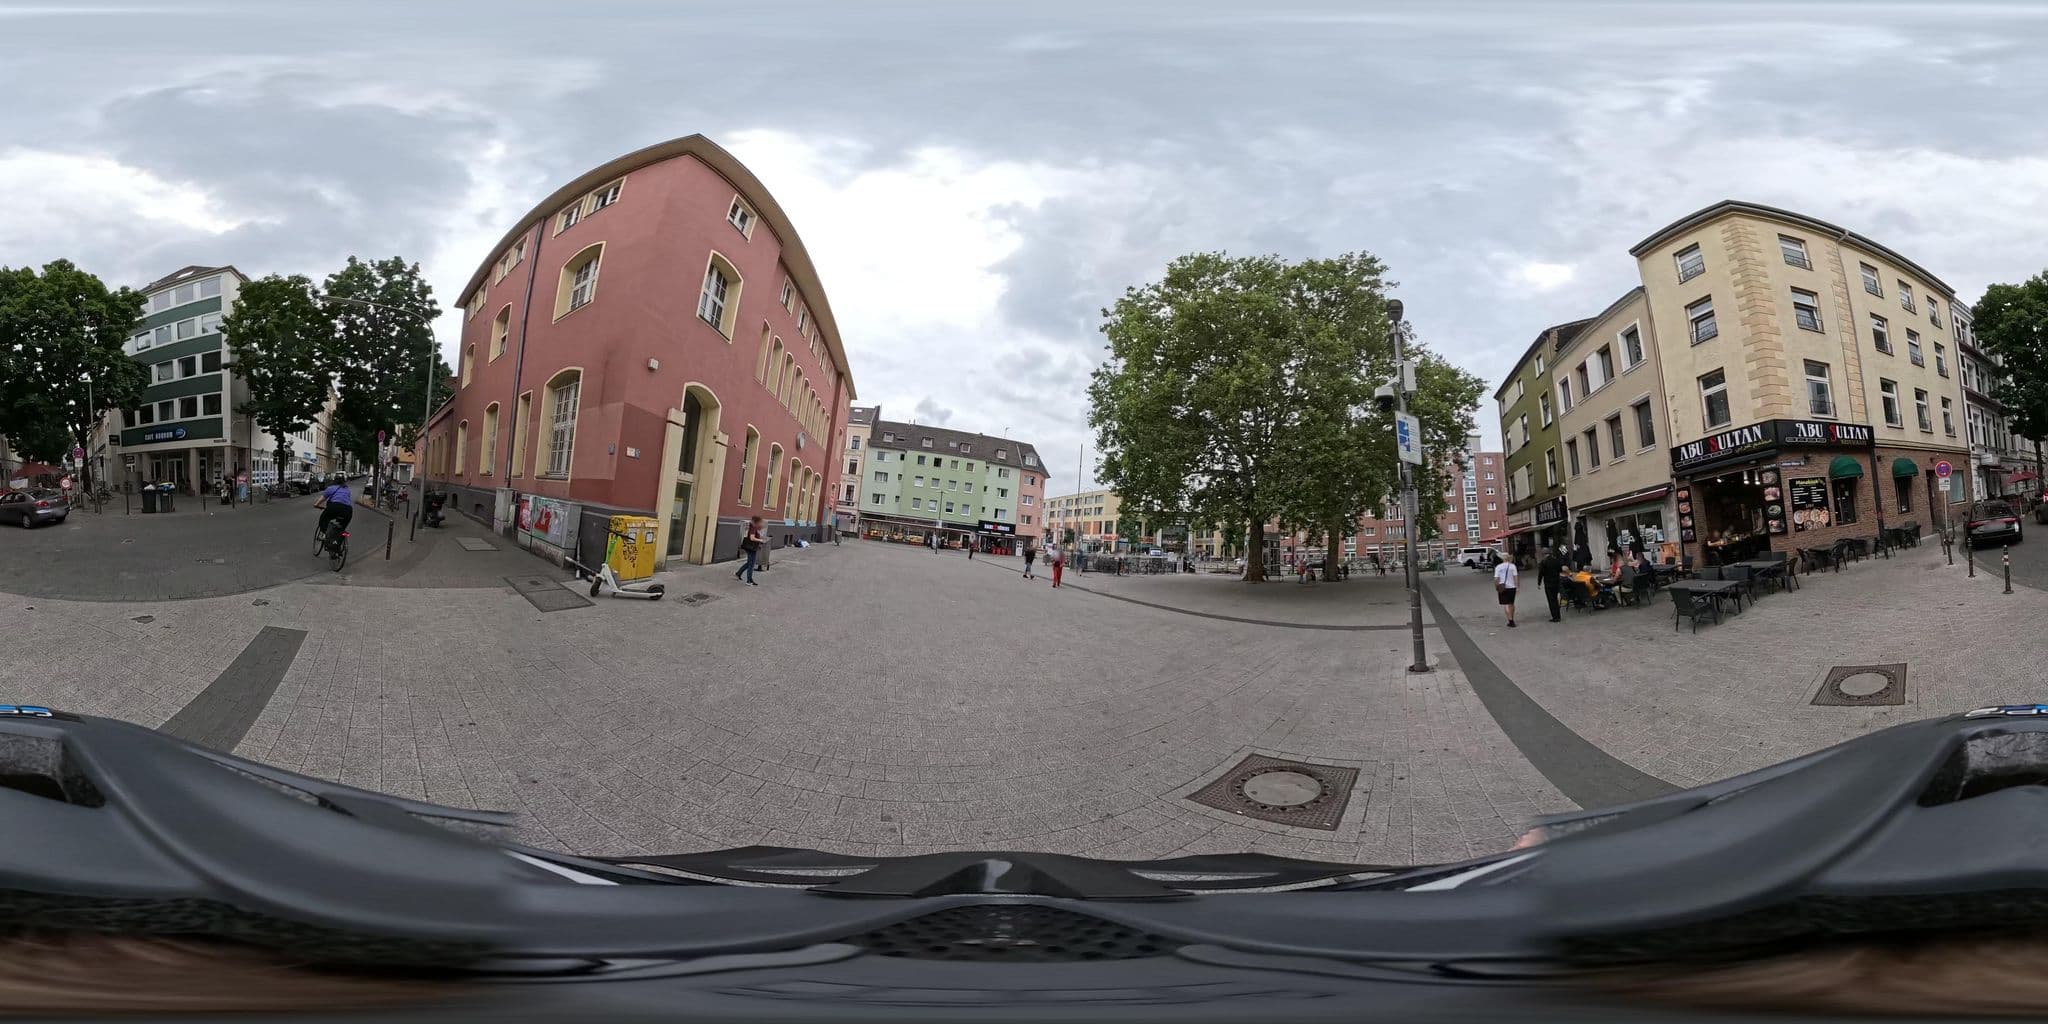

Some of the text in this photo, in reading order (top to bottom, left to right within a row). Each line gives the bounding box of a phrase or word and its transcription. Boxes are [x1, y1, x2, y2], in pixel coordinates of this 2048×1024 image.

[1680, 441, 1704, 460] ABU
[1709, 425, 1762, 453] SULTAN
[1796, 423, 1869, 442] ABU SULTAN
